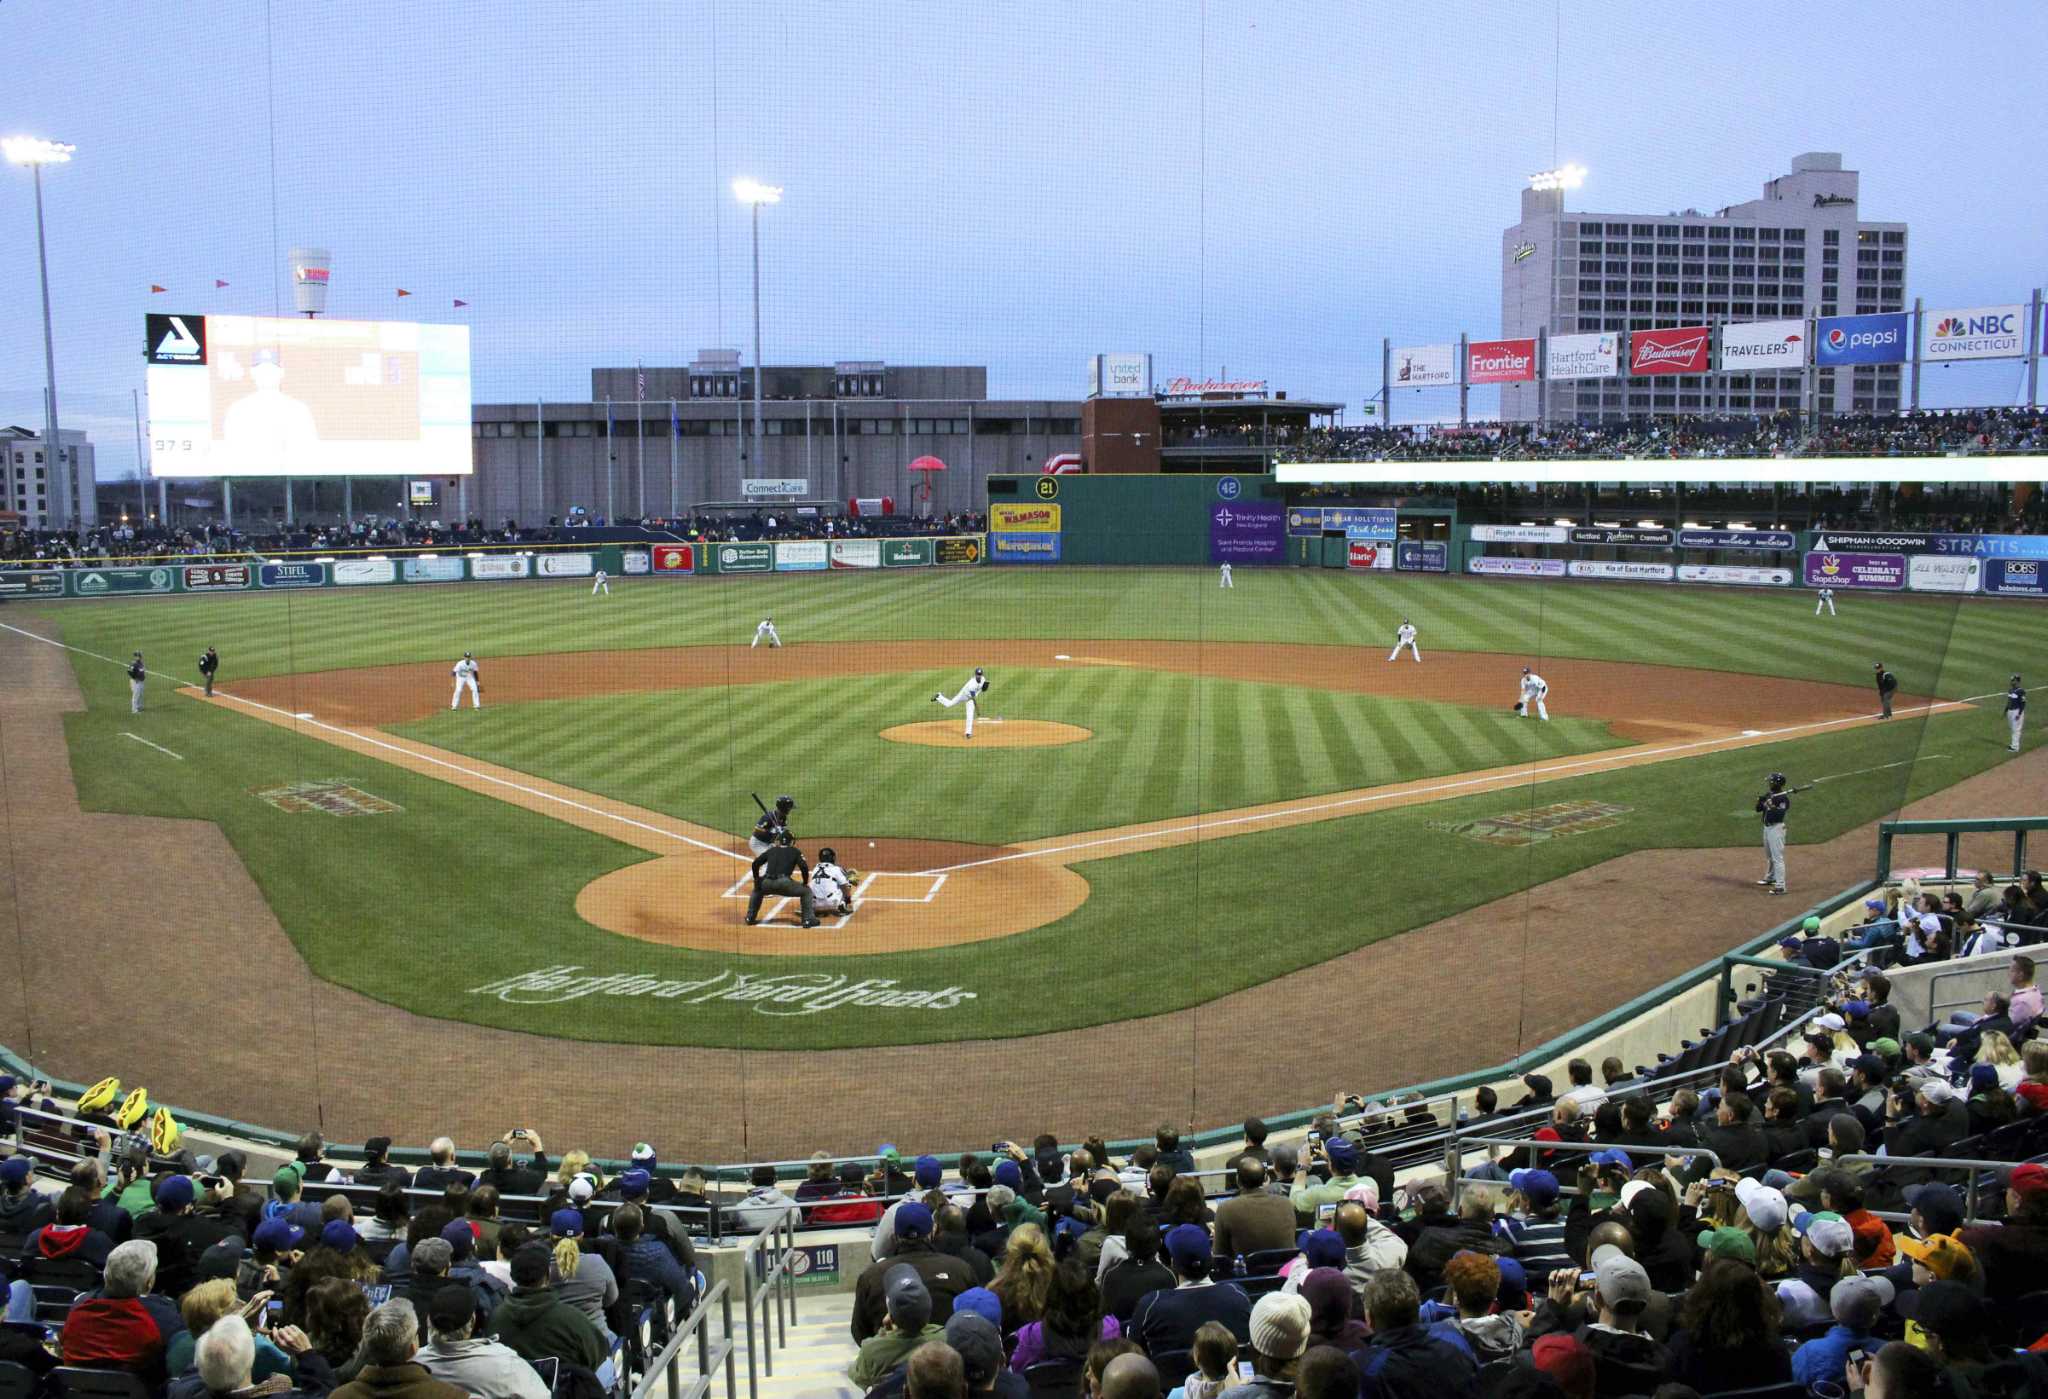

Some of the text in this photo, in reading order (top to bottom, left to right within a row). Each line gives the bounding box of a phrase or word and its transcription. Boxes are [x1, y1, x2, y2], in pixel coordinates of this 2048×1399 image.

[1969, 314, 2015, 336] NBC
[1849, 328, 1897, 348] pepsi
[1640, 341, 1698, 361] Budweiser
[1724, 343, 1788, 357] TRAVELERS
[1930, 338, 2017, 353] CONNECTICUT
[1471, 354, 1530, 371] Frontier
[1551, 351, 1598, 364] Hartford
[1110, 359, 1140, 374] united
[1551, 362, 1610, 375] HealthCare
[1113, 373, 1139, 384] bank
[1412, 372, 1450, 381] HARTFORD
[1471, 369, 1527, 378] COMMUNICATIONS
[1040, 482, 1053, 494] 21
[1221, 482, 1236, 494] 42
[1236, 514, 1257, 523] Trinity
[1257, 514, 1281, 522] Health
[1827, 536, 1871, 545] SHIPMAN
[1876, 537, 1926, 546] GOODWIN
[1935, 538, 2019, 553] STRATIS
[277, 566, 306, 576] STIFEL
[1852, 566, 1902, 576] CELEBRATE
[1858, 575, 1897, 583] SUMMER
[815, 1249, 834, 1265] 110
